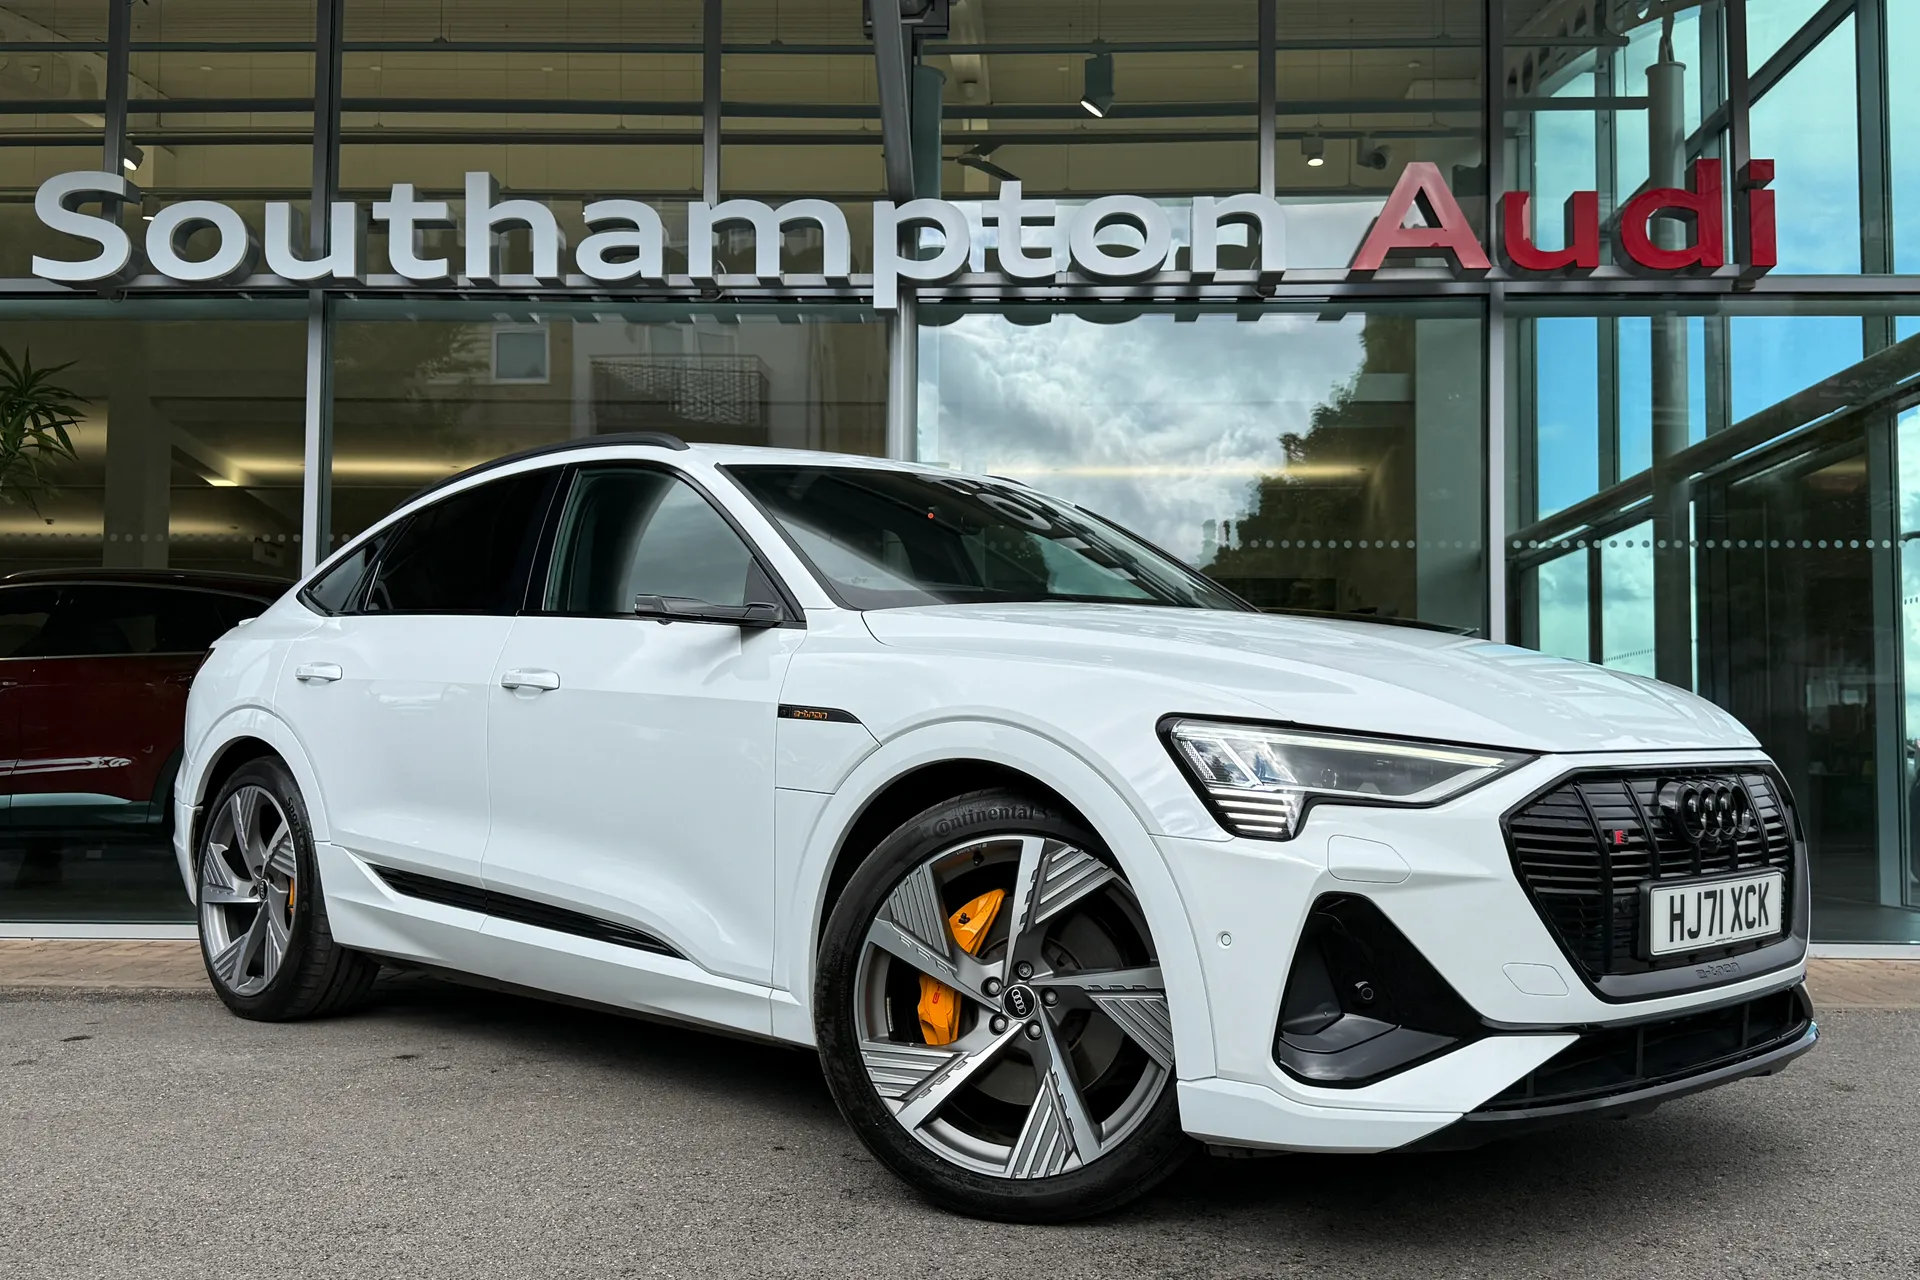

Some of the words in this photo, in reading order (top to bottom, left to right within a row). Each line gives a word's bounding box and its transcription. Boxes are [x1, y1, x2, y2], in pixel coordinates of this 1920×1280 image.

[32, 170, 1287, 312] Southampton
[1351, 159, 1777, 276] Audi
[932, 805, 1034, 838] Continental
[1669, 888, 1724, 943] HJ71
[1730, 881, 1770, 933] XCK
[1695, 960, 1741, 979] e-tron
